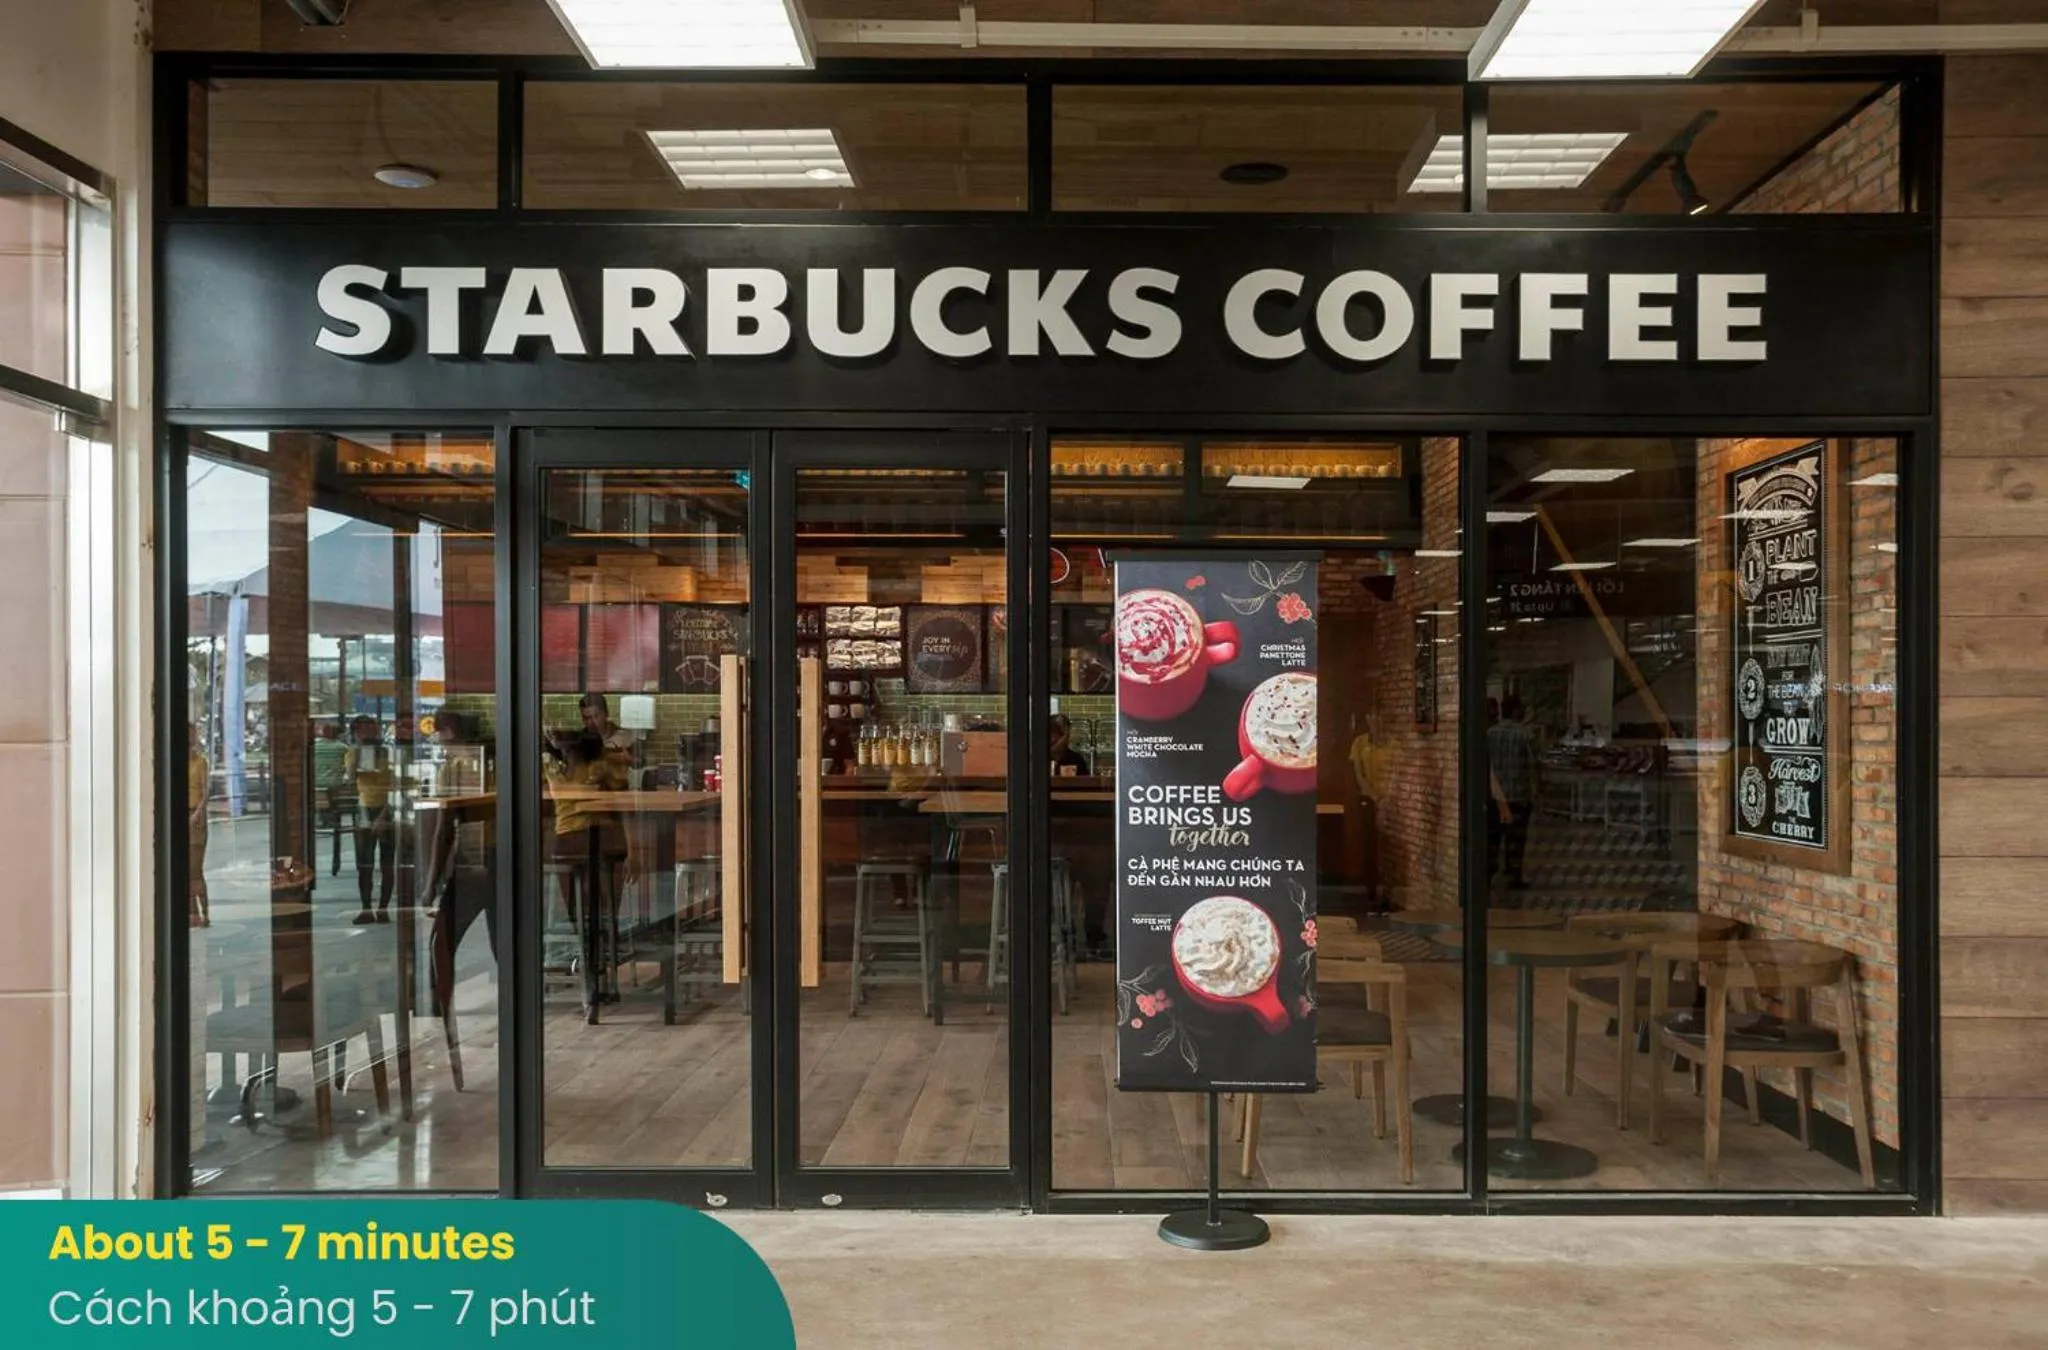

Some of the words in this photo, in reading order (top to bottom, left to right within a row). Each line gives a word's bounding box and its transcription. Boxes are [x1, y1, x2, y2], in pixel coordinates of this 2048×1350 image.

[316, 265, 1181, 358] STARBUCKS
[1226, 270, 1767, 360] COFFEE
[1765, 529, 1817, 565] PLANT
[1766, 586, 1818, 627] BEAN
[922, 645, 950, 653] EVERY
[923, 636, 939, 644] JOY
[941, 636, 950, 644] IN
[1260, 644, 1306, 652] CHRISTMAS
[1281, 659, 1306, 667] LATTE
[1766, 717, 1810, 745] GROW
[1126, 743, 1152, 751] WHITE
[1154, 743, 1204, 751] CHOCOLATE
[1767, 756, 1820, 783] Harvest
[1128, 785, 1221, 804] COFFEE
[1128, 806, 1215, 825] BRINGS
[1222, 806, 1252, 826] US
[1168, 823, 1250, 852] together
[1771, 821, 1815, 840] CHERRY
[1127, 855, 1148, 871] CÀ
[1152, 856, 1181, 871] PHÊ
[1183, 859, 1227, 871] MANG
[1230, 856, 1282, 872] CHÚNG
[1286, 859, 1305, 872] TA
[1127, 873, 1156, 887] ĐẾN
[1194, 876, 1235, 888] NHAU
